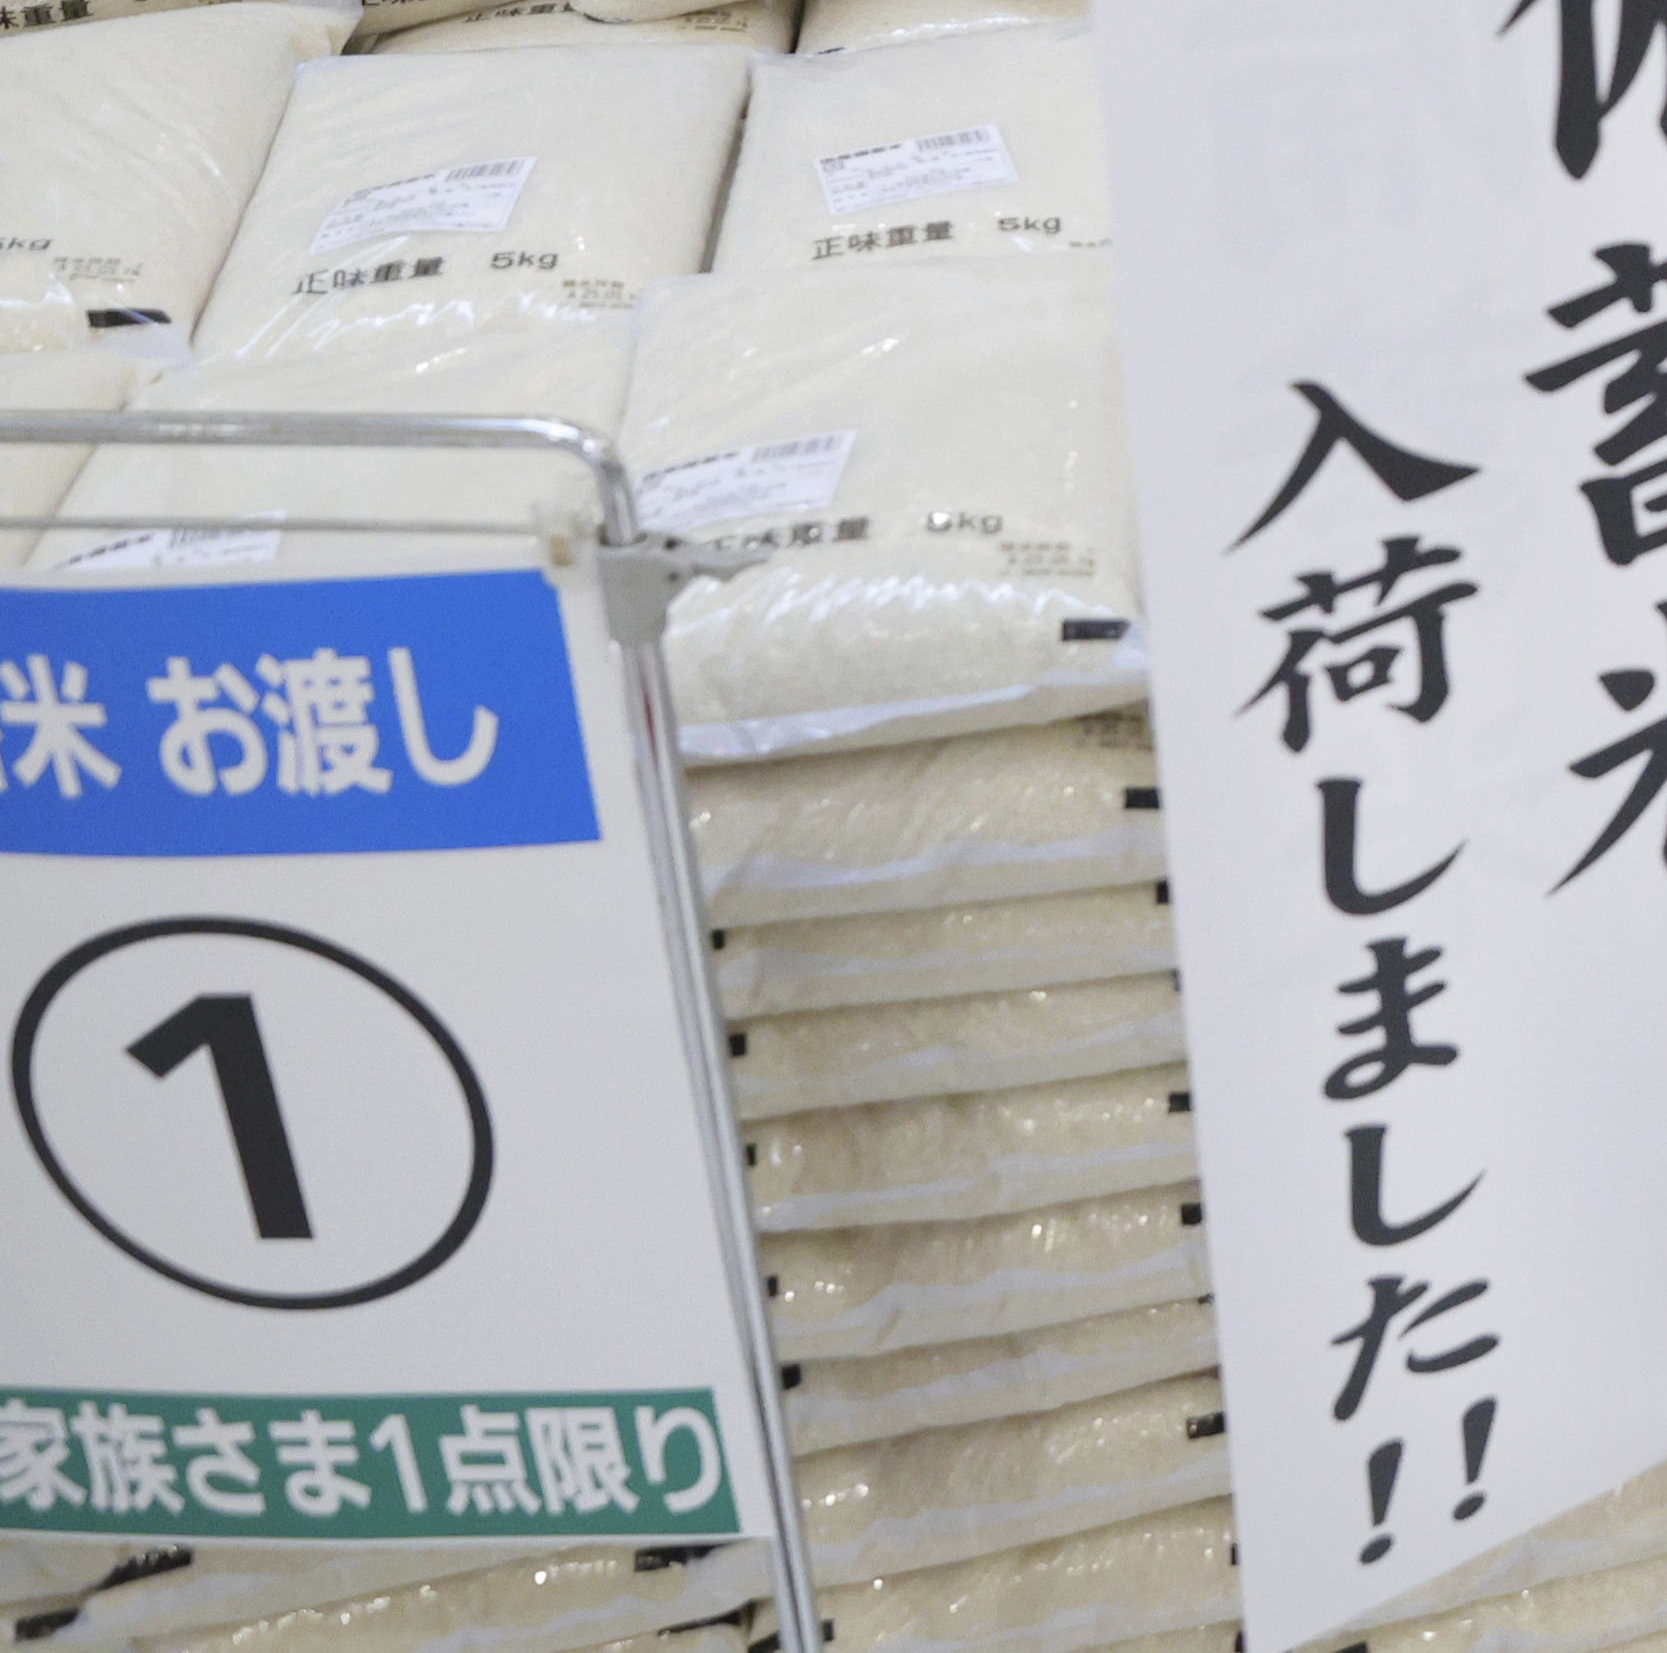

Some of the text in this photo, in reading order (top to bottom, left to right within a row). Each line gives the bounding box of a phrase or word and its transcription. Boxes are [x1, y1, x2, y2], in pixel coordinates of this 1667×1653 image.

[811, 214, 1062, 262] 正味重量 5kg
[291, 251, 561, 297] 正味重量 5kg
[144, 647, 499, 797] お渡し
